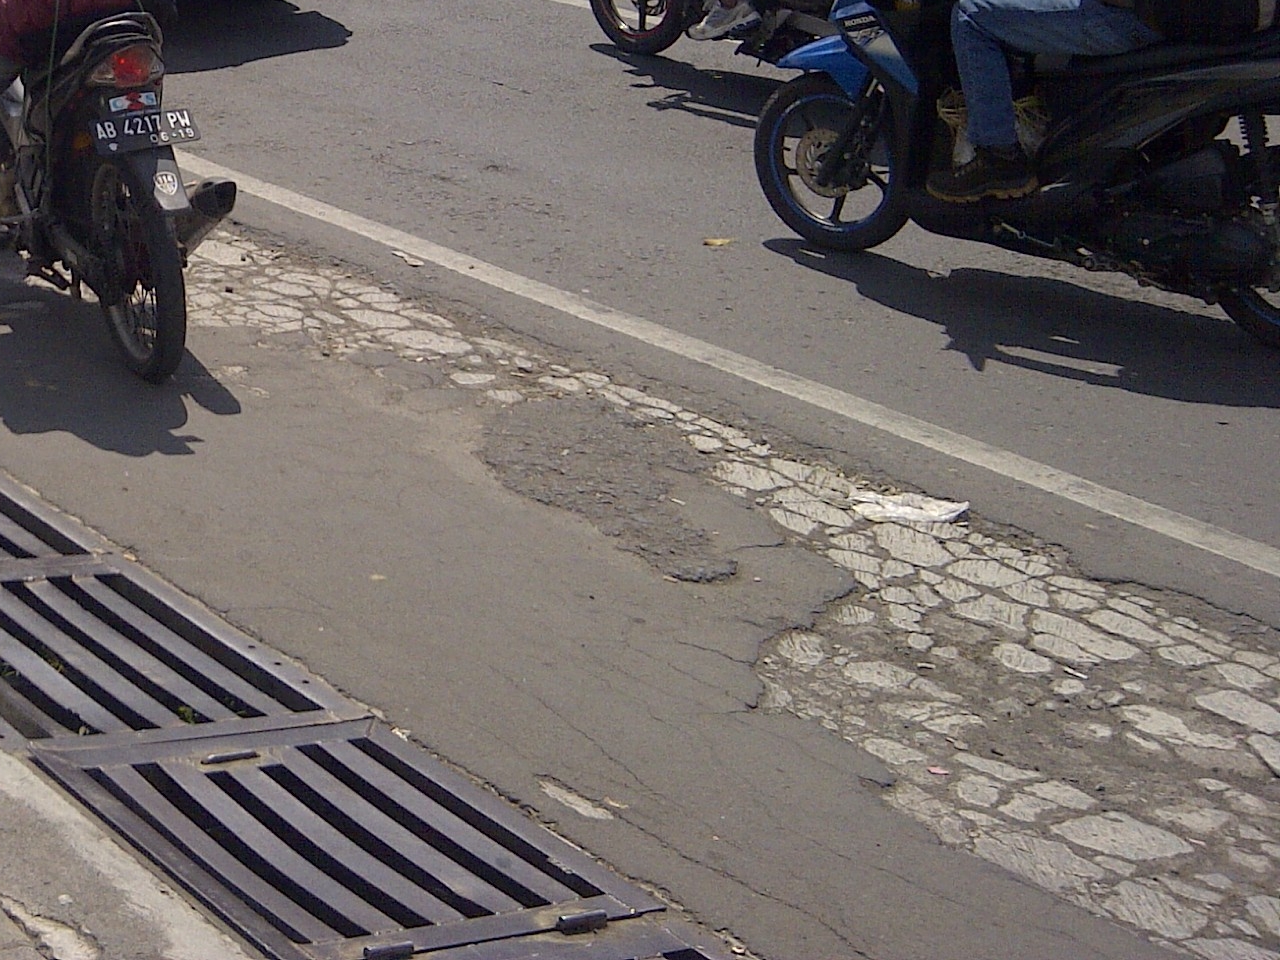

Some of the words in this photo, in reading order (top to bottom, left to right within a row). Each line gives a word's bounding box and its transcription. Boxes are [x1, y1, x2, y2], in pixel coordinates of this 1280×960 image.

[96, 121, 117, 140] AB
[123, 114, 162, 136] 4217
[166, 110, 191, 129] PW
